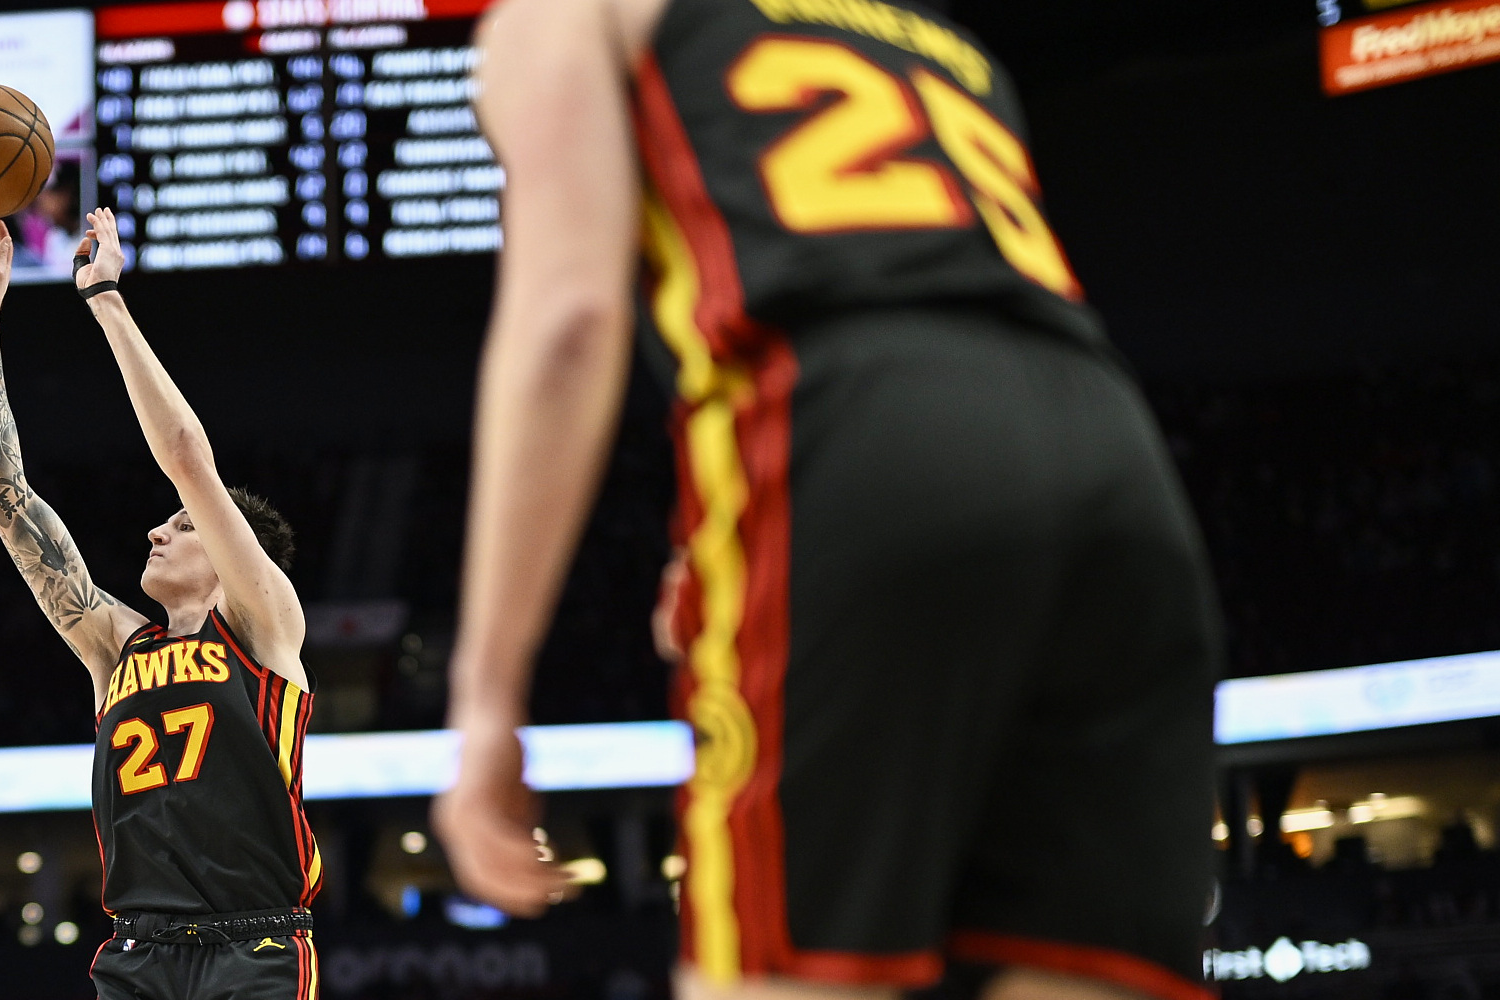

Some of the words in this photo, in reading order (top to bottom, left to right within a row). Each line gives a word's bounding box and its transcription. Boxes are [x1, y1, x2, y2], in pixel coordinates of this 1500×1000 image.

[1351, 4, 1500, 63] FredMeye
[723, 32, 1087, 303] 25
[103, 639, 231, 717] HAWKS
[110, 702, 215, 796] 27
[1300, 938, 1371, 974] Tech
